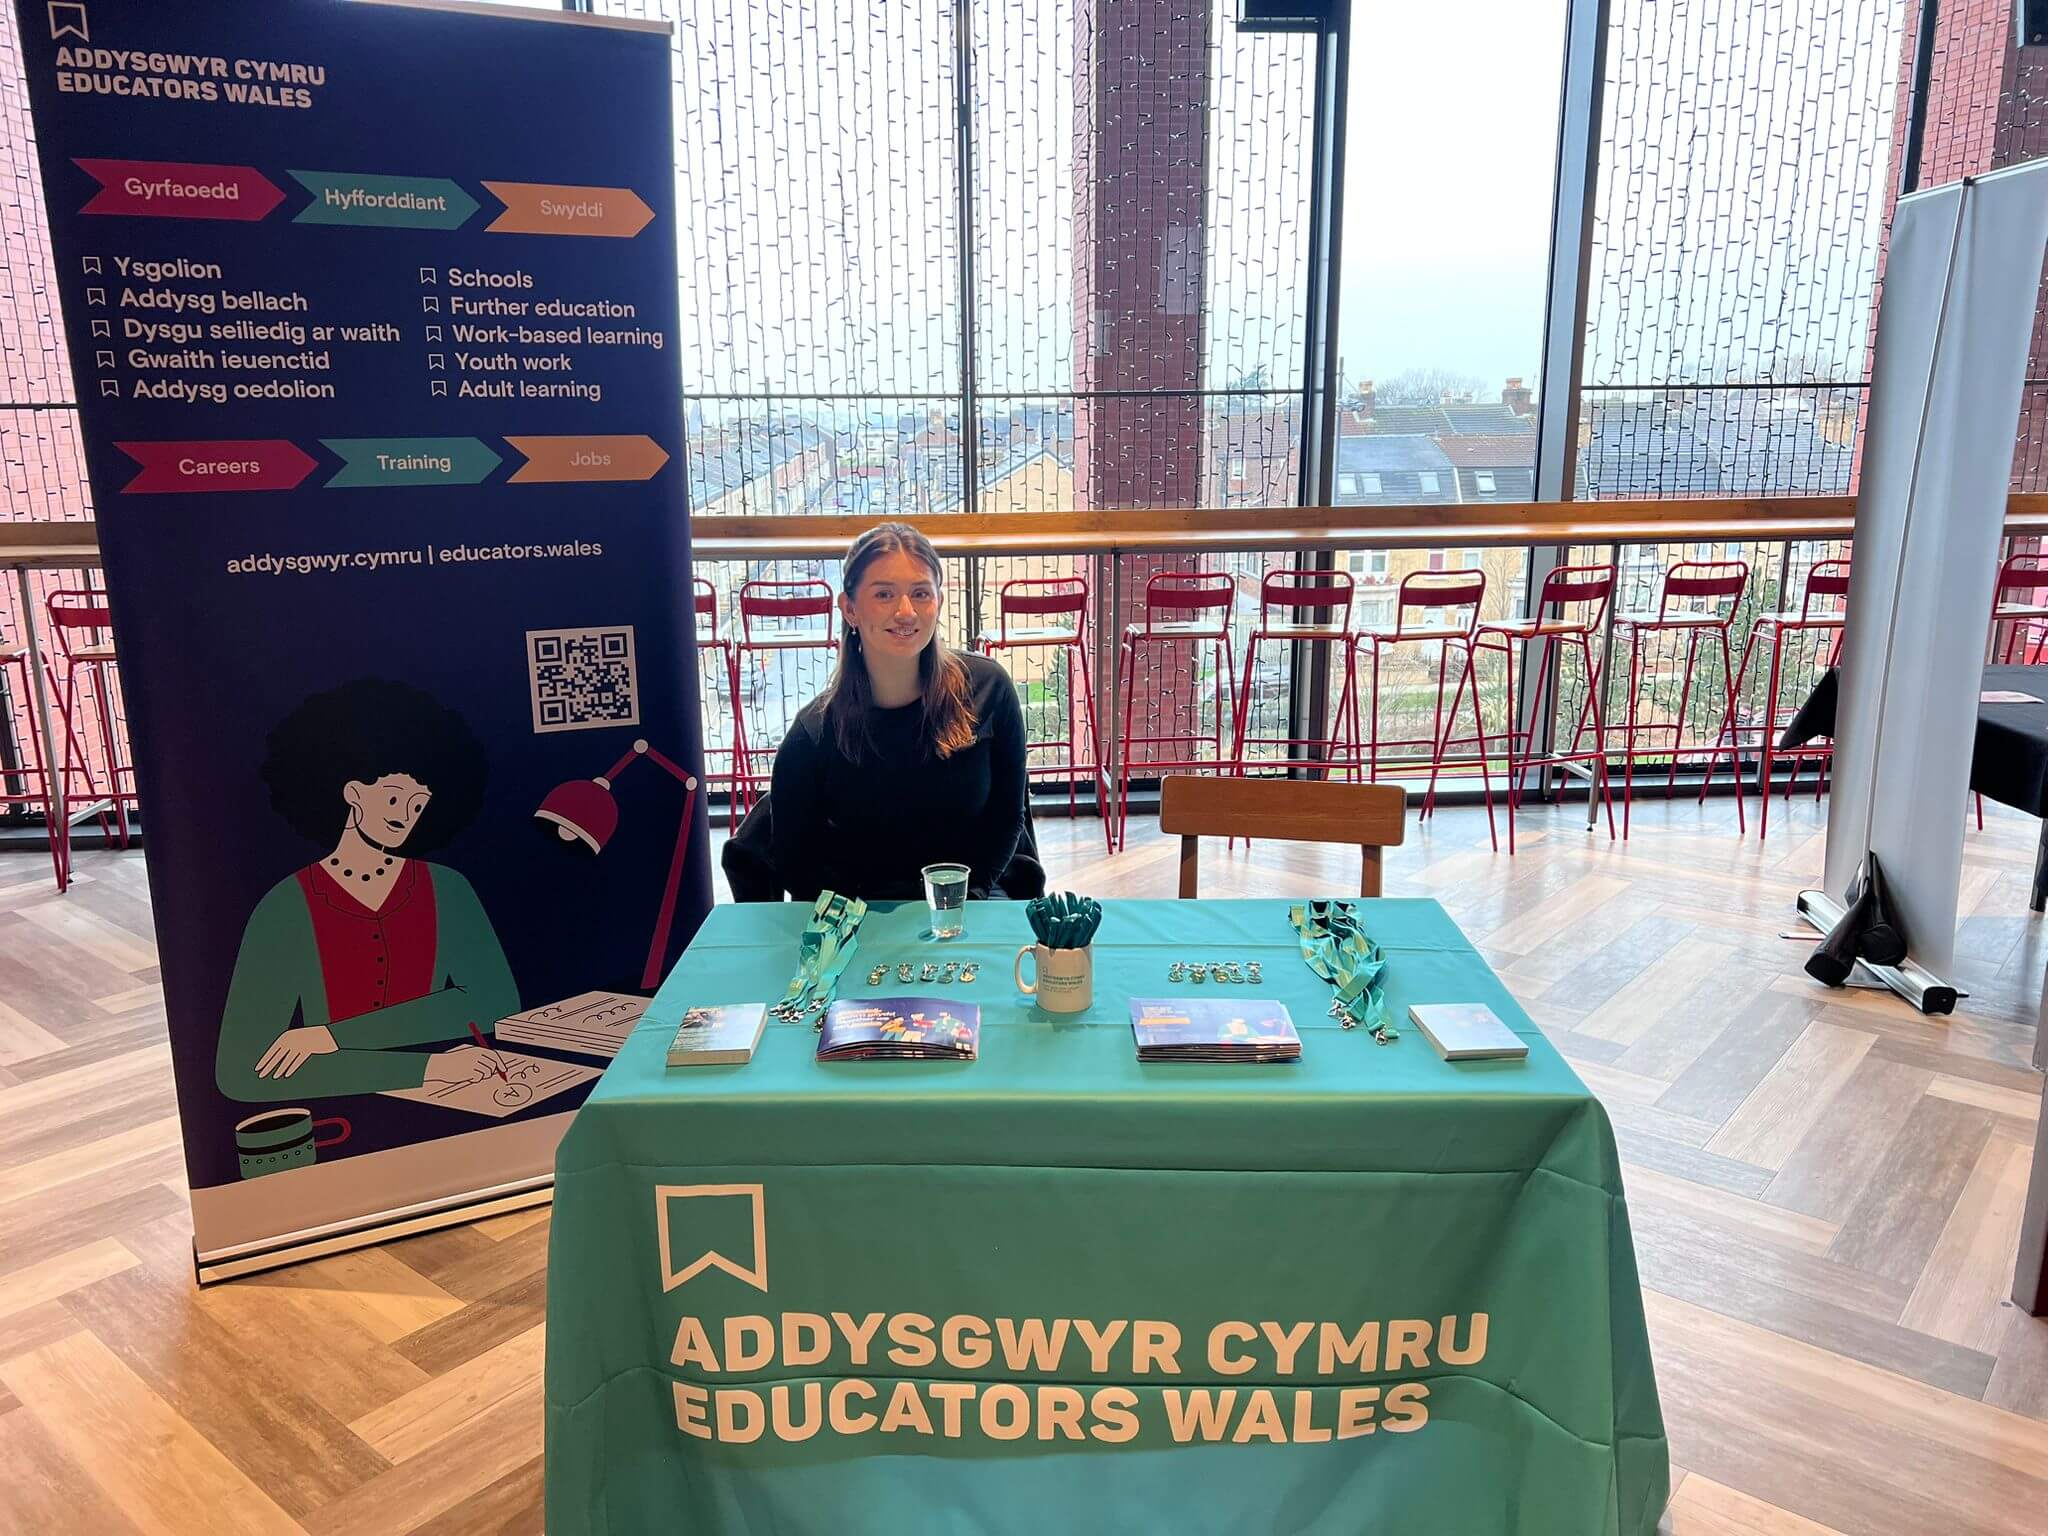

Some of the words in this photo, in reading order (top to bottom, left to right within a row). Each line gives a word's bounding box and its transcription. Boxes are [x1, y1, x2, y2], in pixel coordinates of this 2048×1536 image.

[56, 47, 228, 77] ADDYSGWYR
[234, 60, 325, 86] CYMRU
[57, 72, 218, 101] EDUCATORS
[223, 84, 312, 108] WALES
[125, 178, 238, 199] Gyrfaoedd
[326, 189, 446, 210] Hyfforddiant
[541, 200, 602, 219] Swyddi
[114, 257, 221, 281] Ysgolion
[449, 269, 533, 288] Schools
[120, 288, 215, 313] Addysg
[222, 291, 307, 310] bellach
[451, 297, 529, 315] Further
[535, 299, 634, 317] education
[124, 319, 202, 343] Dysgu
[210, 321, 305, 344] seiliedig
[313, 327, 334, 340] ar
[340, 324, 400, 341] waith
[453, 325, 579, 343] Work-based
[587, 327, 663, 348] learning
[129, 349, 214, 368] Gwaith
[221, 350, 329, 369] ieuenctid
[455, 353, 517, 370] Youth
[523, 354, 572, 370] work
[134, 380, 226, 403] Addysg
[234, 380, 334, 397] oedolion
[459, 380, 514, 397] Adult
[520, 380, 600, 401] learning
[179, 459, 260, 474] Careers
[377, 455, 450, 472] Training
[569, 451, 611, 466] Jobs
[228, 550, 421, 575] addysgwyr.cymru
[440, 540, 602, 561] educators.wales
[670, 1312, 1183, 1375] ADDYSGWYR
[1207, 1312, 1489, 1374] CYMRU
[672, 1380, 1140, 1443] EDUCATORS
[1164, 1384, 1430, 1444] WALES
